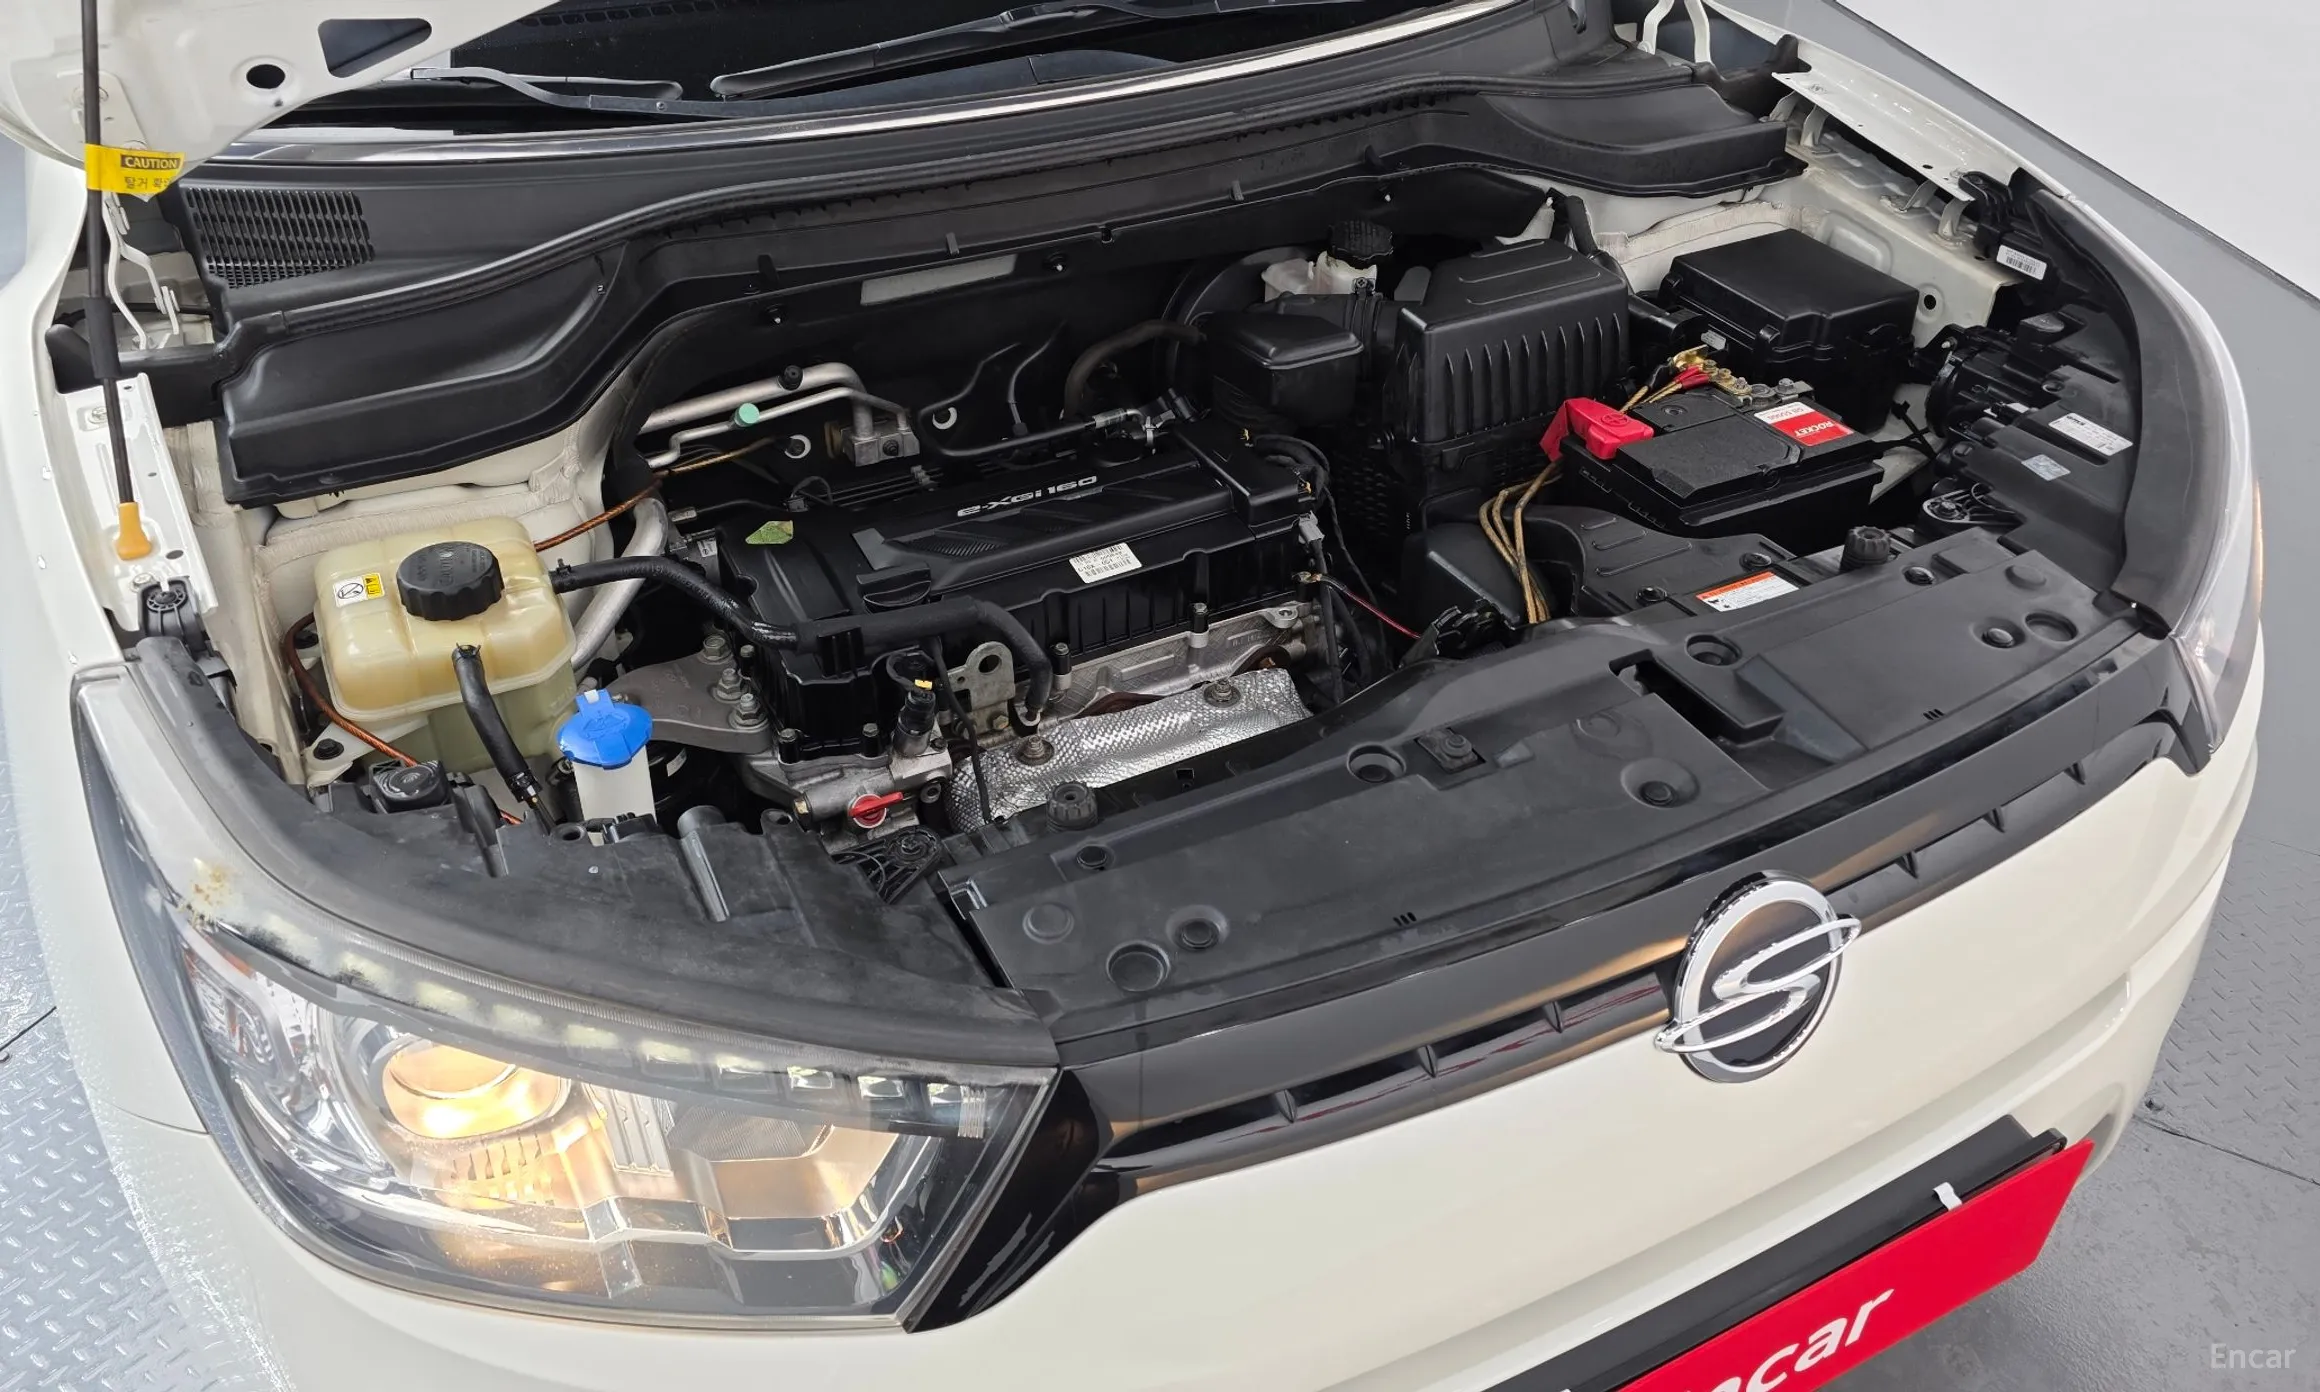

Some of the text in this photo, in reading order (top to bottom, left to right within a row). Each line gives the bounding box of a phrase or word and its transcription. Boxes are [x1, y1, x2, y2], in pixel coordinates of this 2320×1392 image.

[124, 156, 178, 169] CAUTION
[1795, 420, 1835, 437] ROCKET
[1048, 475, 1098, 494] 160
